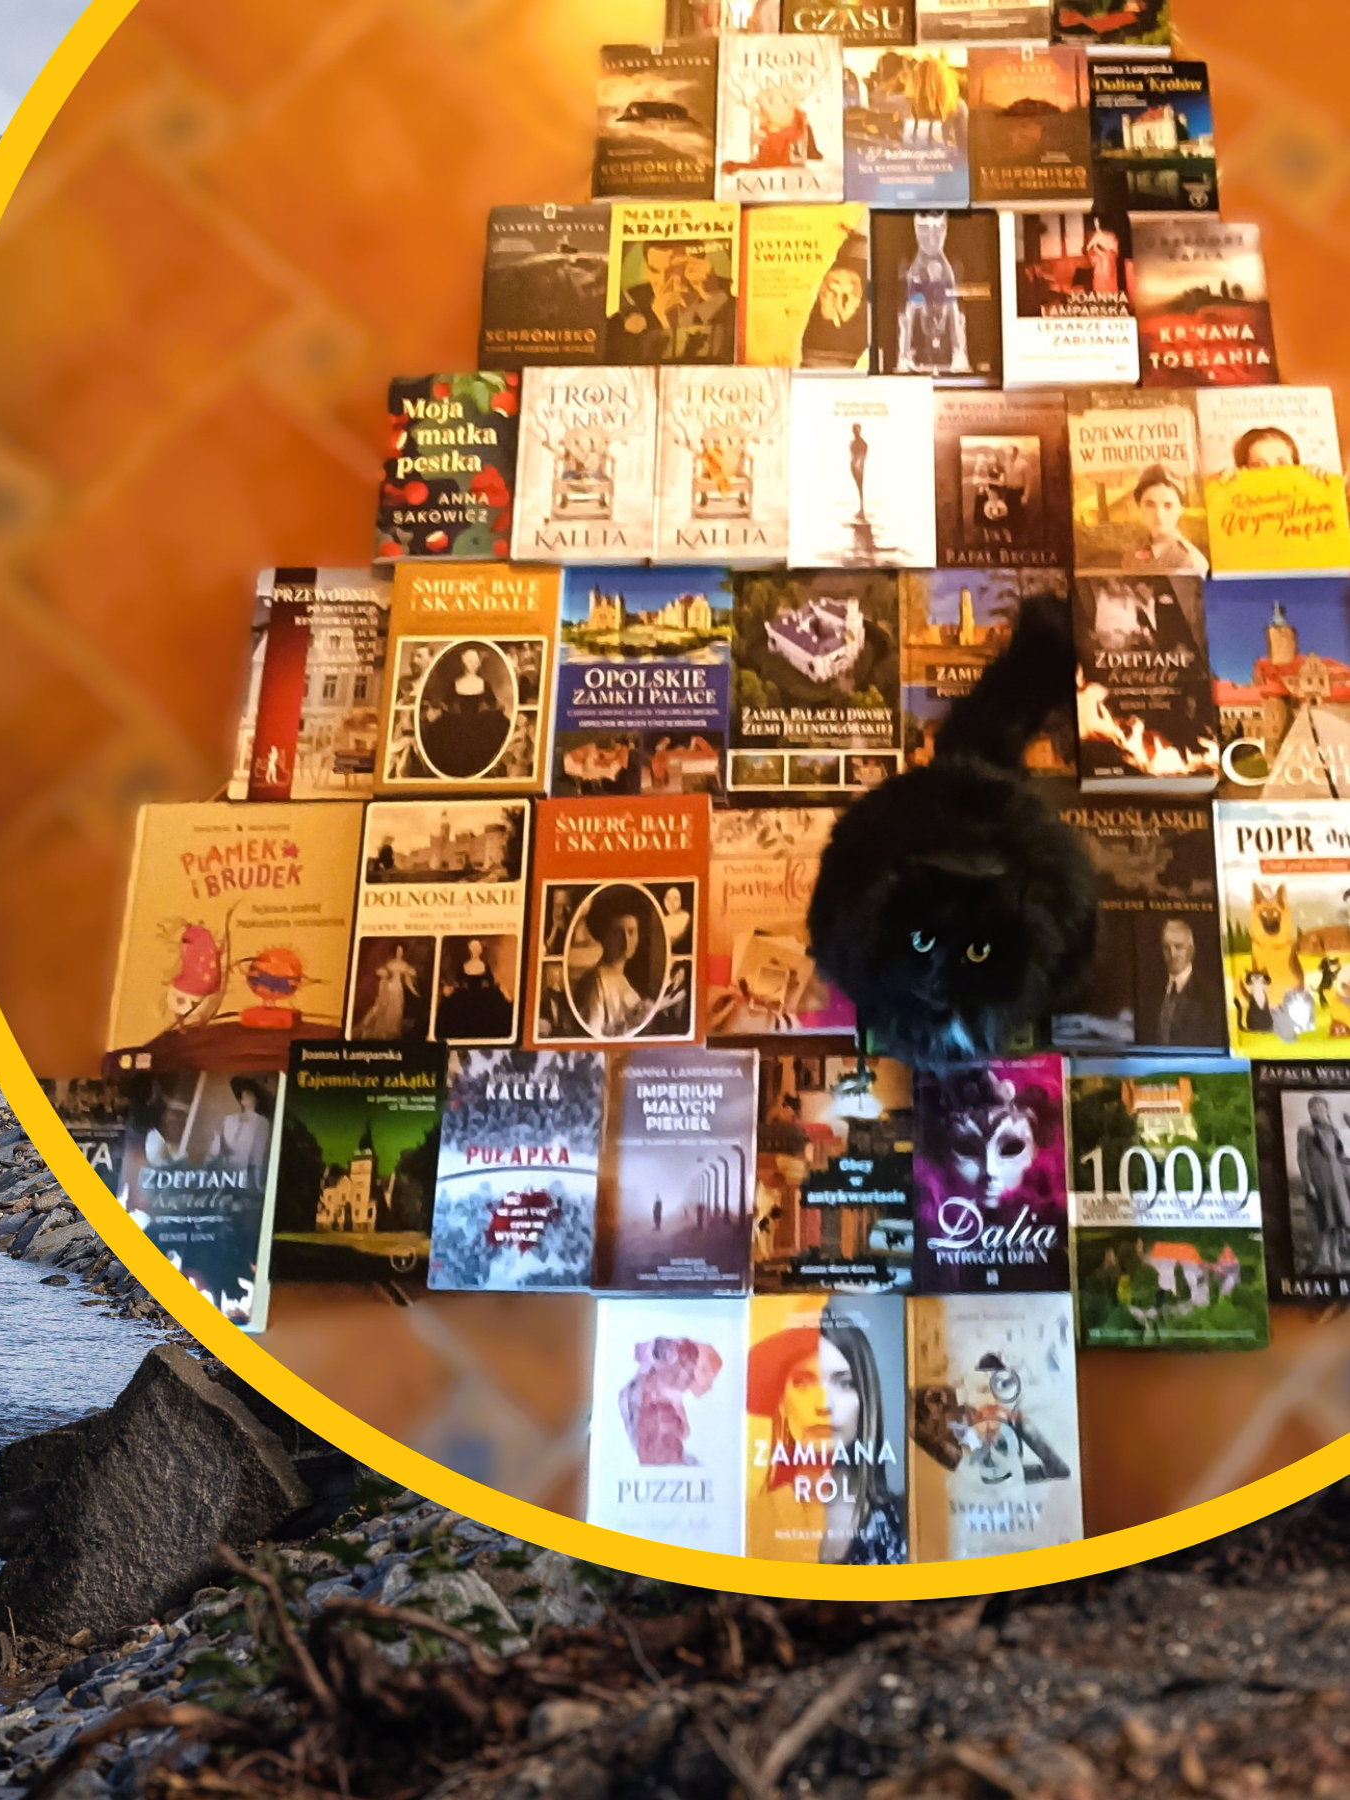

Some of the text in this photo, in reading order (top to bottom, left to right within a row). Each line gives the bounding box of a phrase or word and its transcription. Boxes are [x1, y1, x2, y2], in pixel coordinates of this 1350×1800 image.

[793, 6, 905, 33] CZASU
[1093, 76, 1203, 93] Dolina Królów
[754, 239, 819, 250] OSTATNI
[754, 250, 824, 263] ŚWIADEK
[1066, 290, 1129, 304] JOANNA
[1039, 304, 1130, 318] LAMPARSKA
[1052, 335, 1131, 347] ZABIJANIA
[402, 397, 464, 423] Moja
[416, 422, 498, 446] matka
[1079, 422, 1180, 443] DZIEWCZYNA
[395, 450, 483, 480] pestka
[438, 491, 491, 506] ANNA
[392, 507, 490, 525] SAKOWICZ
[272, 587, 381, 603] PRZEWODNIK
[491, 578, 540, 596] BALE
[419, 595, 540, 612] SKANDALE
[584, 667, 707, 690] OPOLSKIE
[572, 688, 633, 706] ZAMKI
[641, 813, 694, 833] BALE
[567, 832, 694, 853] SKANDALE
[1236, 826, 1315, 855] POPR
[180, 838, 279, 876] PLAMEK
[203, 863, 305, 899] BRUDEK
[296, 1069, 437, 1090] Tajemnicze zakątki
[485, 1083, 560, 1101] KALETA
[636, 1083, 724, 1100] IMPERIUM
[642, 1100, 716, 1115] MAŁYCH
[646, 1116, 712, 1132] PIEKIEŁ
[465, 1145, 571, 1166] PUŁAPKA
[139, 1167, 248, 1190] ZDEPTANE
[1078, 1144, 1250, 1213] 1000
[927, 1196, 1058, 1250] Dalia
[752, 1438, 898, 1468] ZAMIANA
[617, 1479, 714, 1504] PUZZLE
[794, 1468, 857, 1504] RÓL
